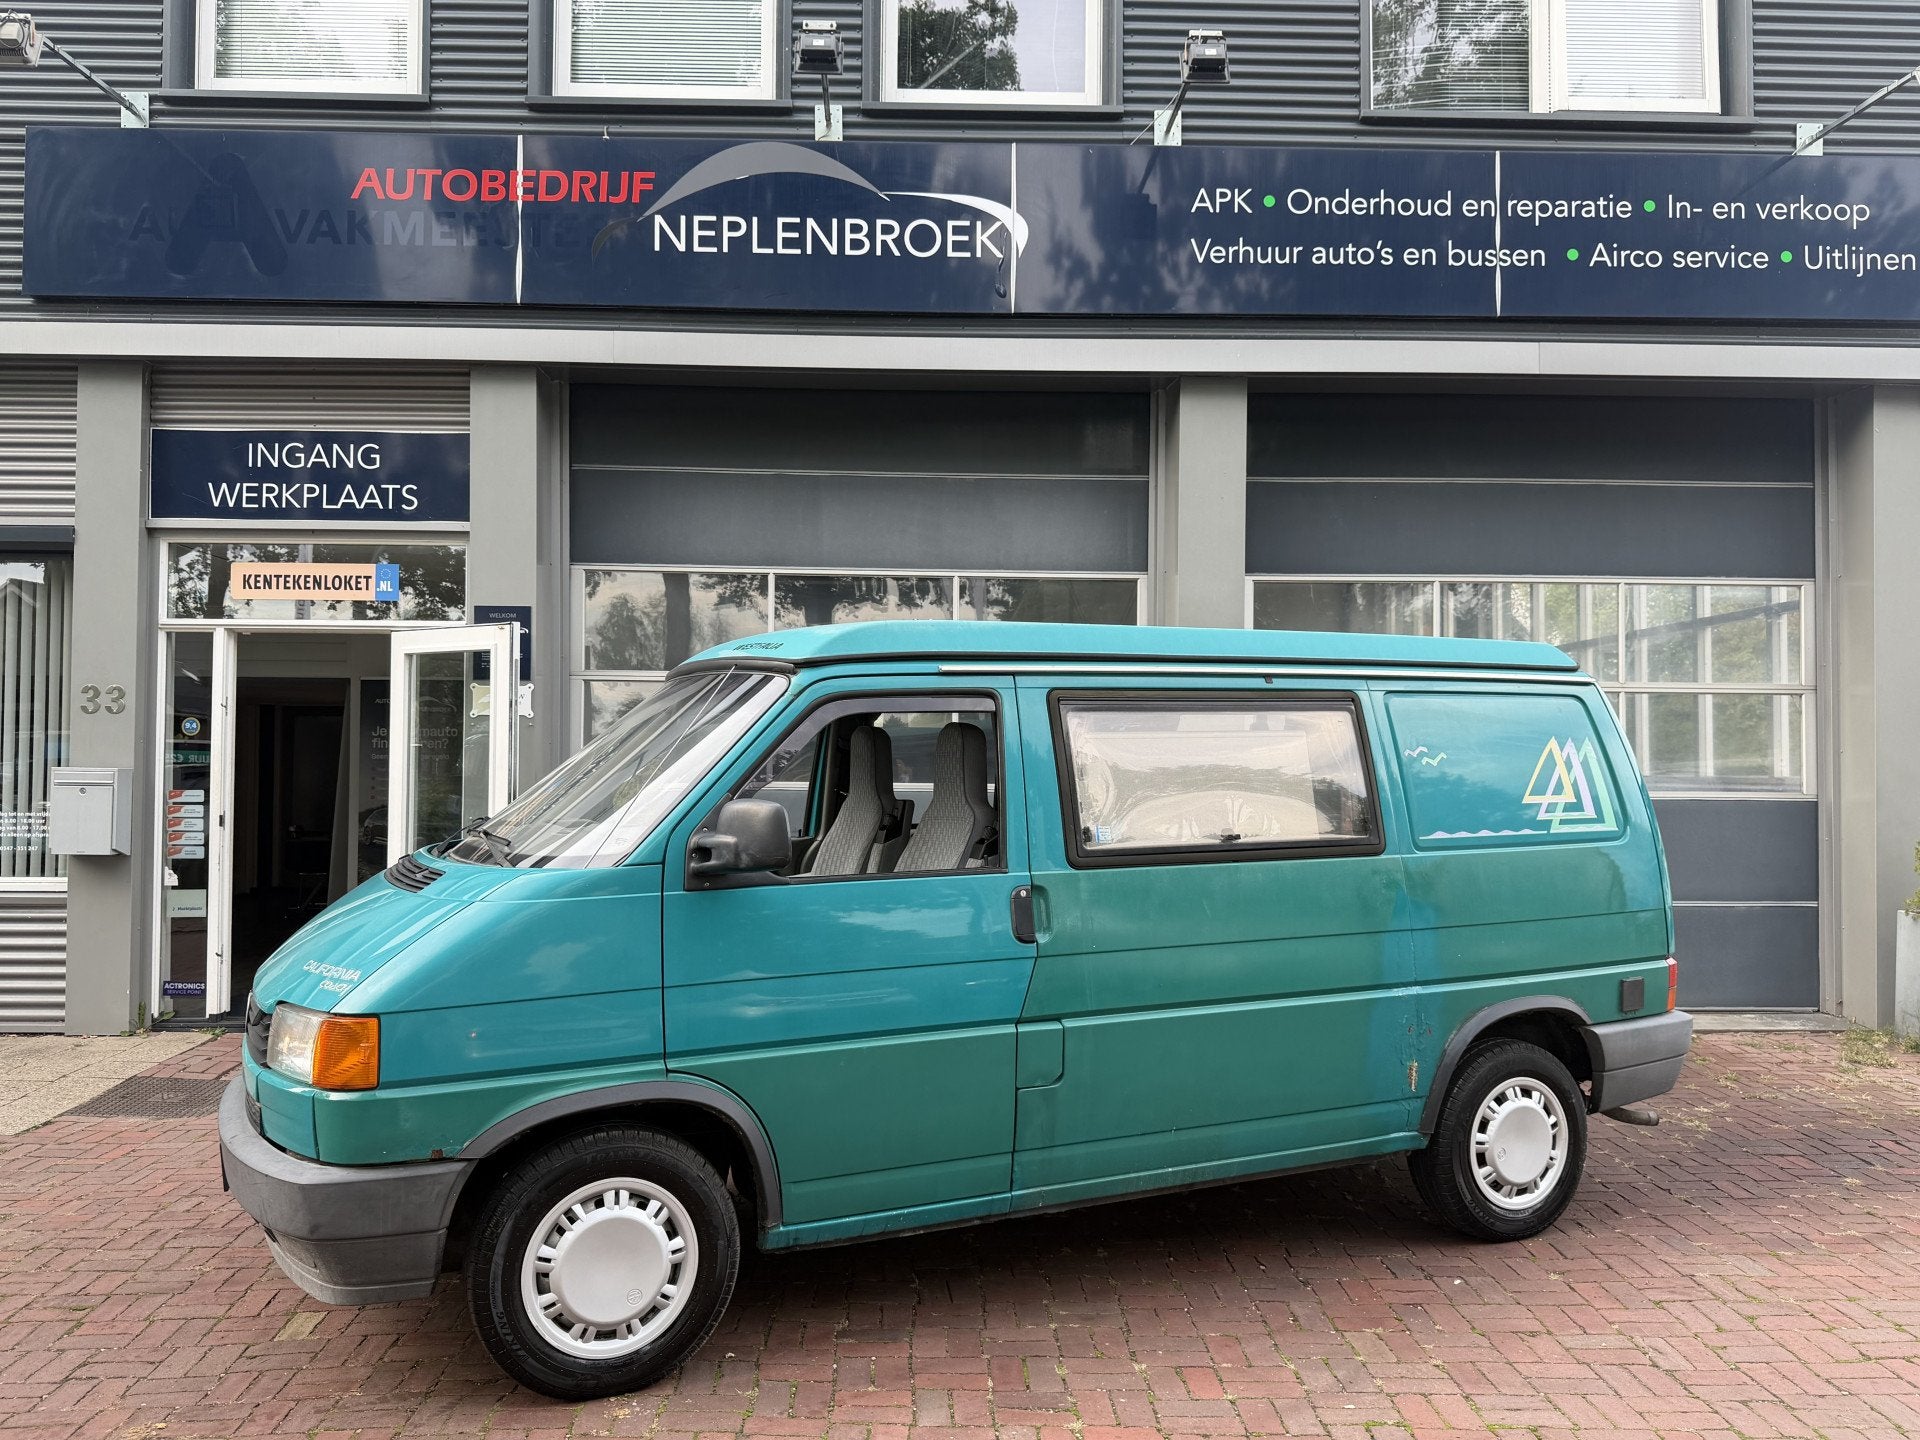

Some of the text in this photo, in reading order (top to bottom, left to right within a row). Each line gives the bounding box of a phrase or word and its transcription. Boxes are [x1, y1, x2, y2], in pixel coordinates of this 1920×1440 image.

[351, 168, 656, 204] AUTOBEDRIJF
[1190, 187, 1871, 230] APK Onderhoud en reparatie In- en verkoop
[654, 214, 1004, 259] NEPLENBROEK
[1190, 237, 1303, 265] Verhuur
[1403, 247, 1437, 266] en
[1448, 239, 1546, 267] bussen
[1589, 242, 1663, 269] Airco
[1672, 244, 1769, 269] service
[1804, 245, 1917, 278] Uitlijnen
[248, 442, 380, 470] INGANG
[207, 482, 418, 511] WERKPLAATS
[242, 574, 372, 591] KENTEKENLOKET
[80, 684, 126, 715] 33
[371, 726, 388, 737] Je
[303, 960, 361, 982] CALIFORNIA
